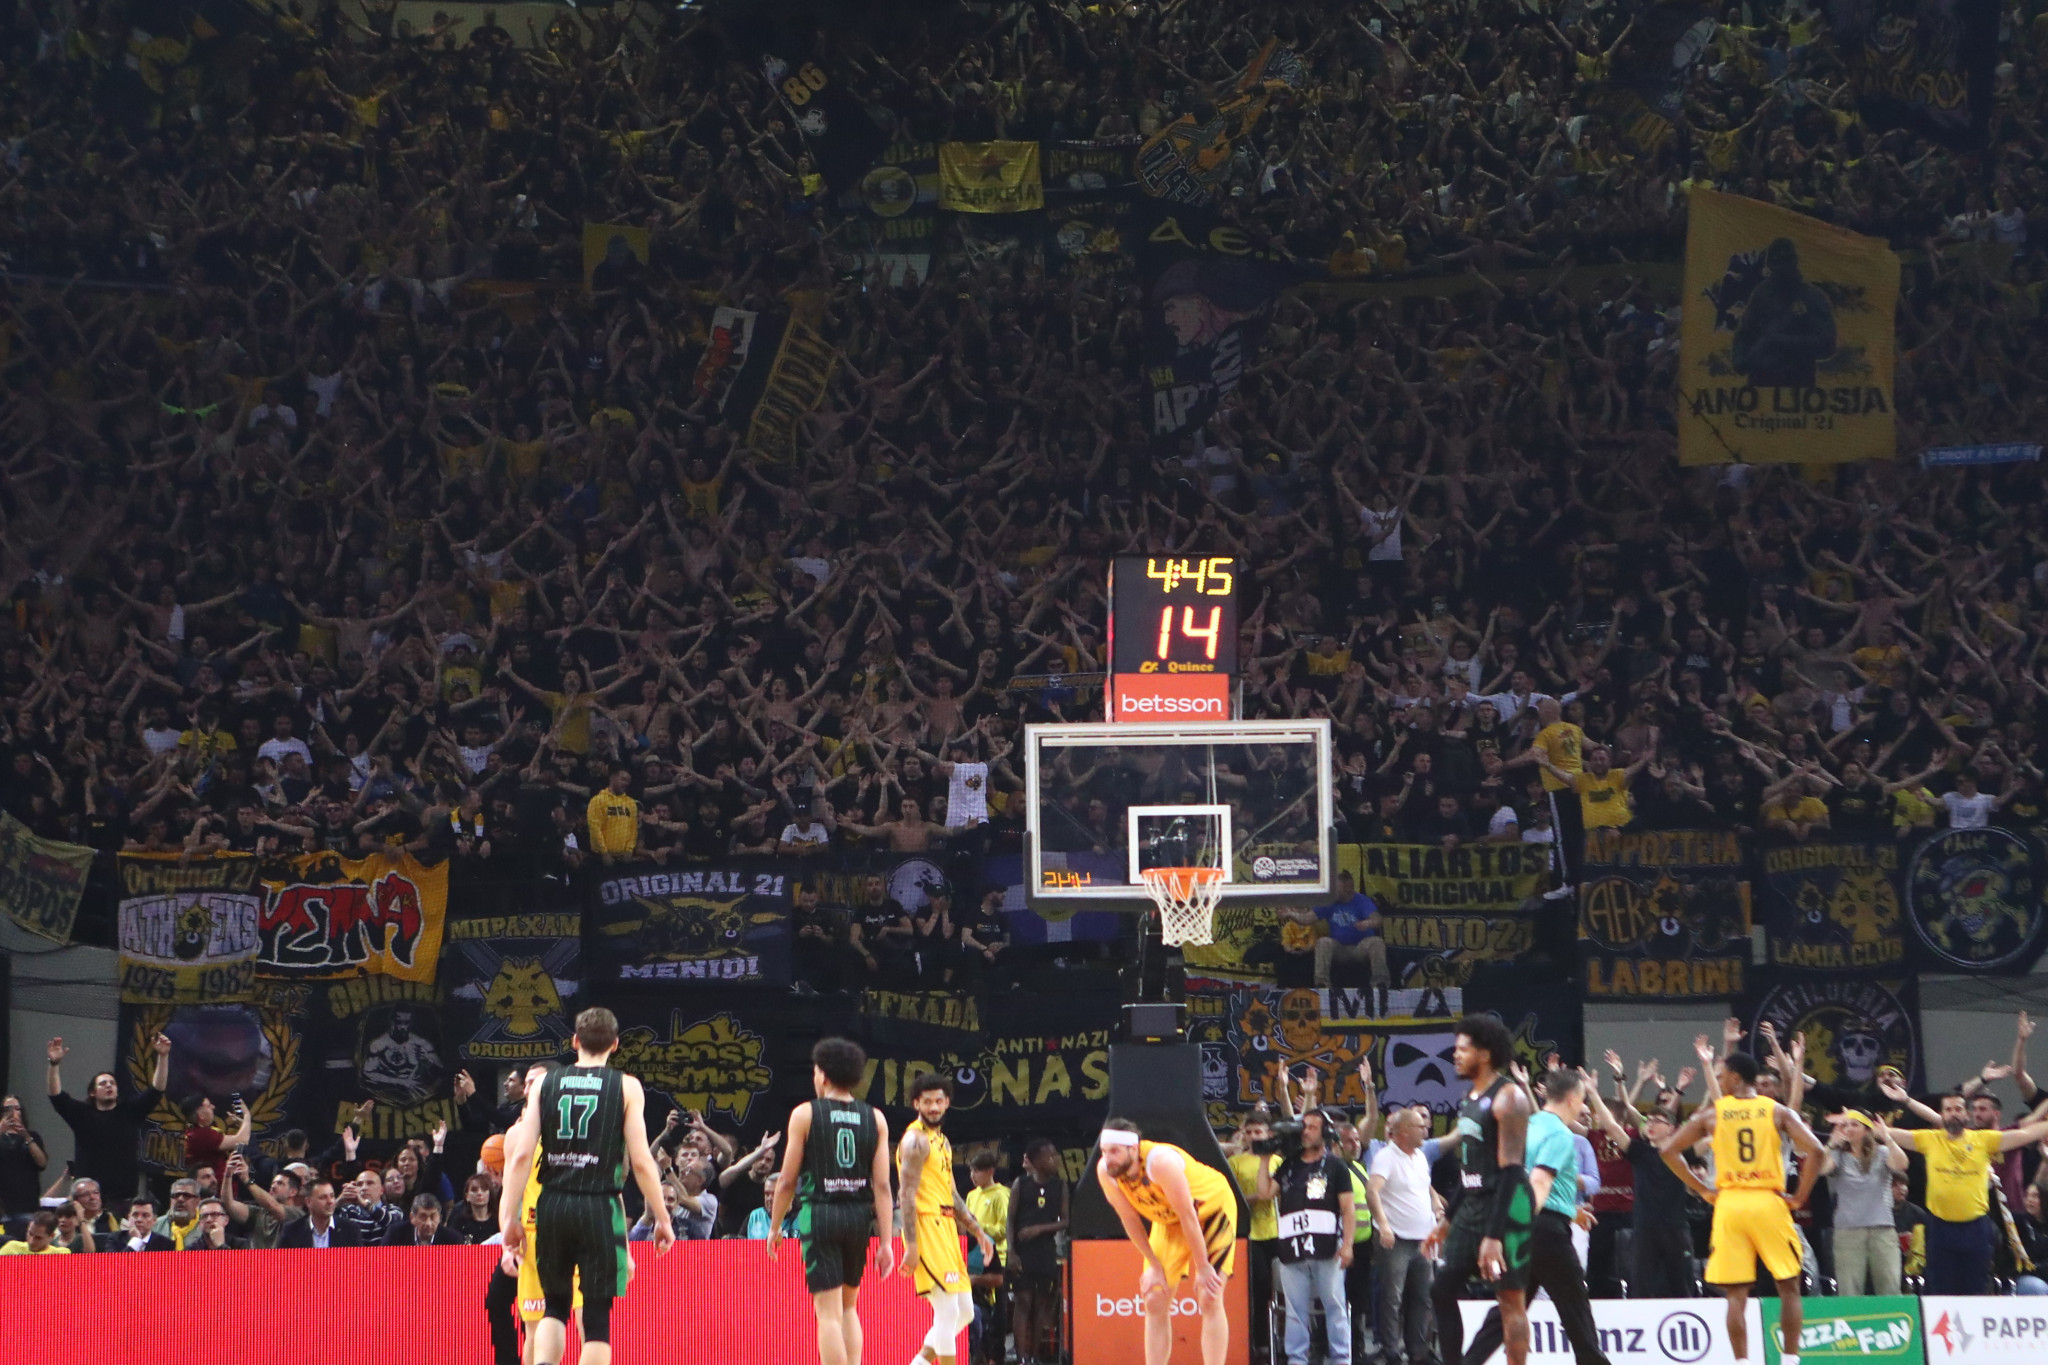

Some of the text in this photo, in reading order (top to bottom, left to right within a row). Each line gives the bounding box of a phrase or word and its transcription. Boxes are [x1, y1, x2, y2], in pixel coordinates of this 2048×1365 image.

[782, 61, 828, 106] 86
[1693, 386, 1889, 415] ANO LIOSIA
[1146, 557, 1234, 596] 4:45
[1157, 605, 1222, 660] 14
[1167, 661, 1215, 674] Quince
[1121, 693, 1222, 713] betsson
[1367, 843, 1545, 879] ALIARTOS
[1765, 844, 1867, 874] ORIGINAL
[600, 870, 746, 905] ORIGINAL
[753, 873, 785, 897] 21
[1397, 881, 1515, 905] ORIGINAL
[1382, 916, 1488, 950] KIATO
[1772, 937, 1903, 967] LAMIA CLUB
[121, 963, 177, 1000] 1975
[199, 960, 258, 1000] 1982
[468, 1040, 557, 1058] ORIGINAL
[995, 1029, 1110, 1055] ANTI NAZI
[625, 1063, 675, 1074] VIOLENCE
[556, 1094, 599, 1140] 17
[836, 1127, 856, 1169] 0
[1737, 1127, 1756, 1164] 8
[1290, 1233, 1315, 1258] 14
[1982, 1316, 2048, 1338] PAPP
